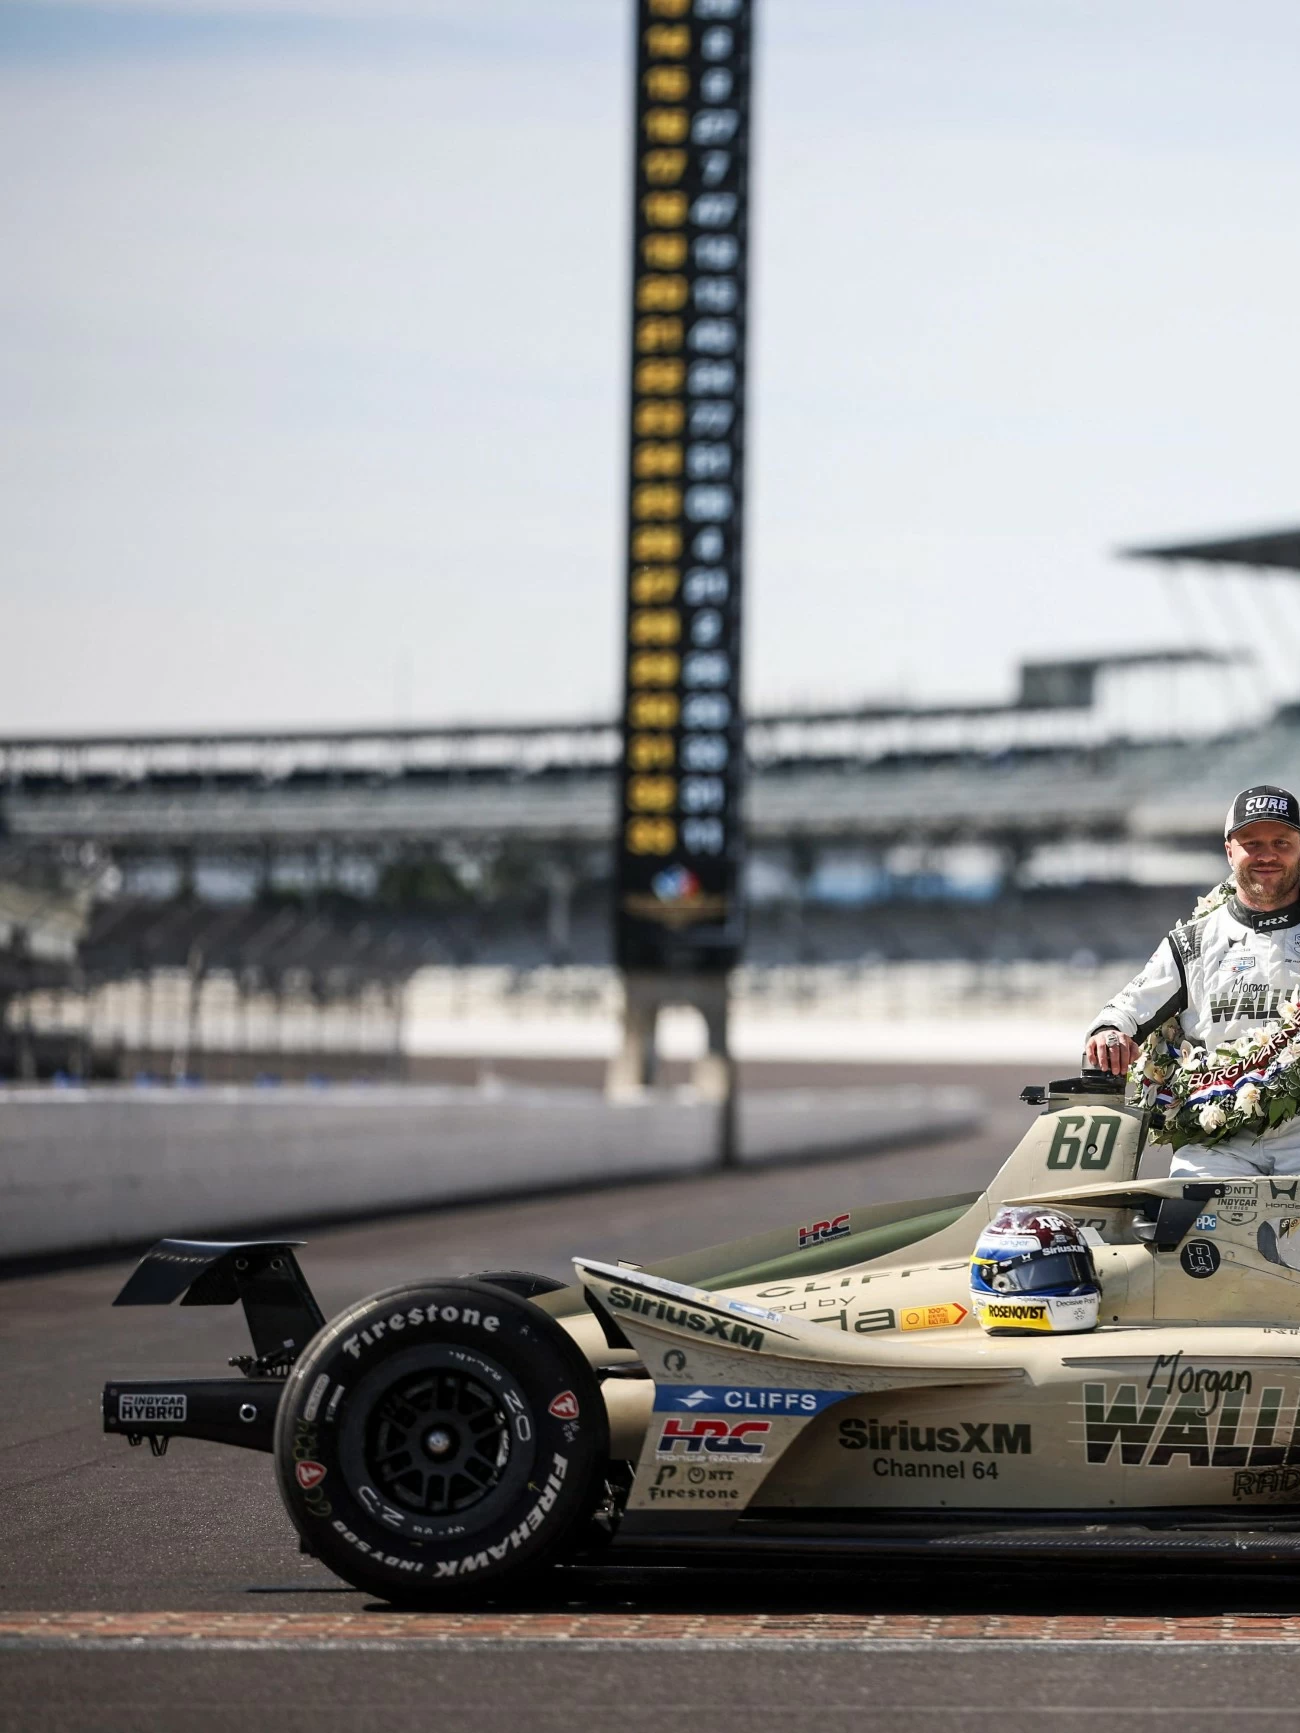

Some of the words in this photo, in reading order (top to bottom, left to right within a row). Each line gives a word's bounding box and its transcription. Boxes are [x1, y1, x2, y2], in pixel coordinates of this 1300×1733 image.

[1246, 798, 1288, 811] CURB
[1258, 915, 1289, 927] HRX
[1232, 976, 1270, 1000] Morgan
[1047, 1115, 1121, 1170] 60
[1234, 1186, 1254, 1195] NTT
[1266, 1202, 1300, 1210] Honda
[1196, 1215, 1216, 1229] PPG
[798, 1213, 850, 1247] HRC
[1042, 1245, 1085, 1256] SiriusXM
[819, 1296, 855, 1307] by
[607, 1286, 765, 1352] SiriusXM
[988, 1305, 1046, 1319] ROSENQVIST
[342, 1303, 500, 1359] Firestone
[1147, 1350, 1252, 1417] Morgan
[134, 1396, 184, 1405] INDYCAR
[724, 1391, 817, 1410] CLIFFS
[122, 1406, 184, 1419] HYBRID
[656, 1418, 772, 1455] HRC
[838, 1417, 1032, 1456] SiriusXM
[708, 1471, 735, 1481] NTT
[872, 1458, 966, 1482] Channel
[972, 1460, 999, 1481] 64
[648, 1487, 739, 1500] Firestone
[432, 1452, 569, 1578] FIREHAWK
